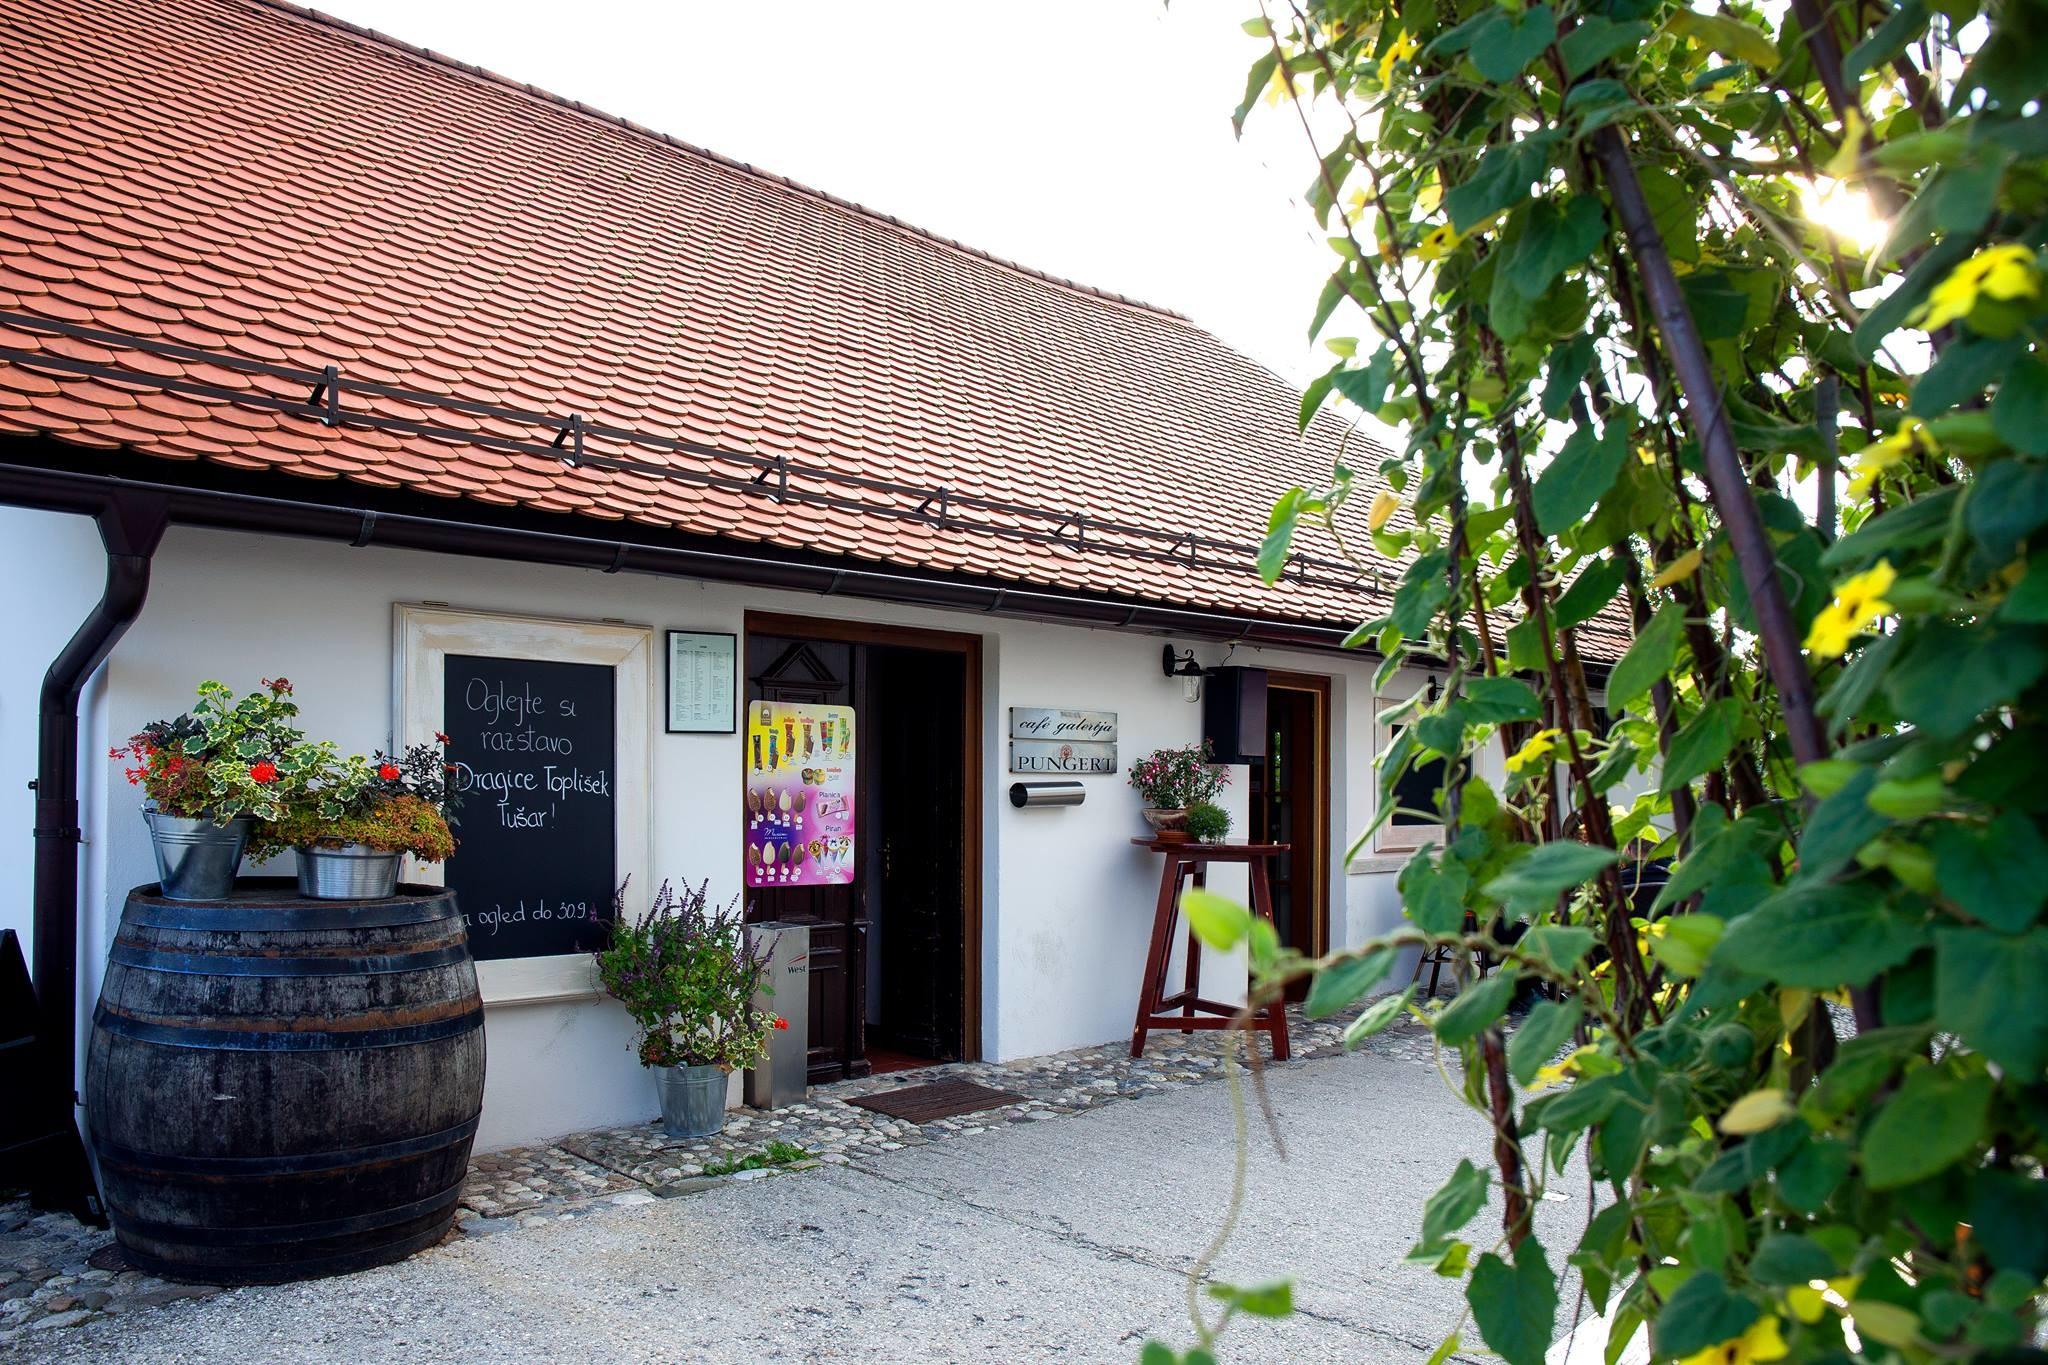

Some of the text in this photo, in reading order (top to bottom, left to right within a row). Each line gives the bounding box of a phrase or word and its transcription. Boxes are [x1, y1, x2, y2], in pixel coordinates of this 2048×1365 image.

[466, 678, 577, 726] Oglejte si
[480, 724, 573, 755] razstavo
[1053, 718, 1113, 737] galerija
[1018, 756, 1115, 771] PUNGERT
[455, 761, 610, 802] Dragice Toplišek
[478, 899, 526, 936] ogled
[532, 899, 552, 920] do
[787, 965, 806, 974] West
